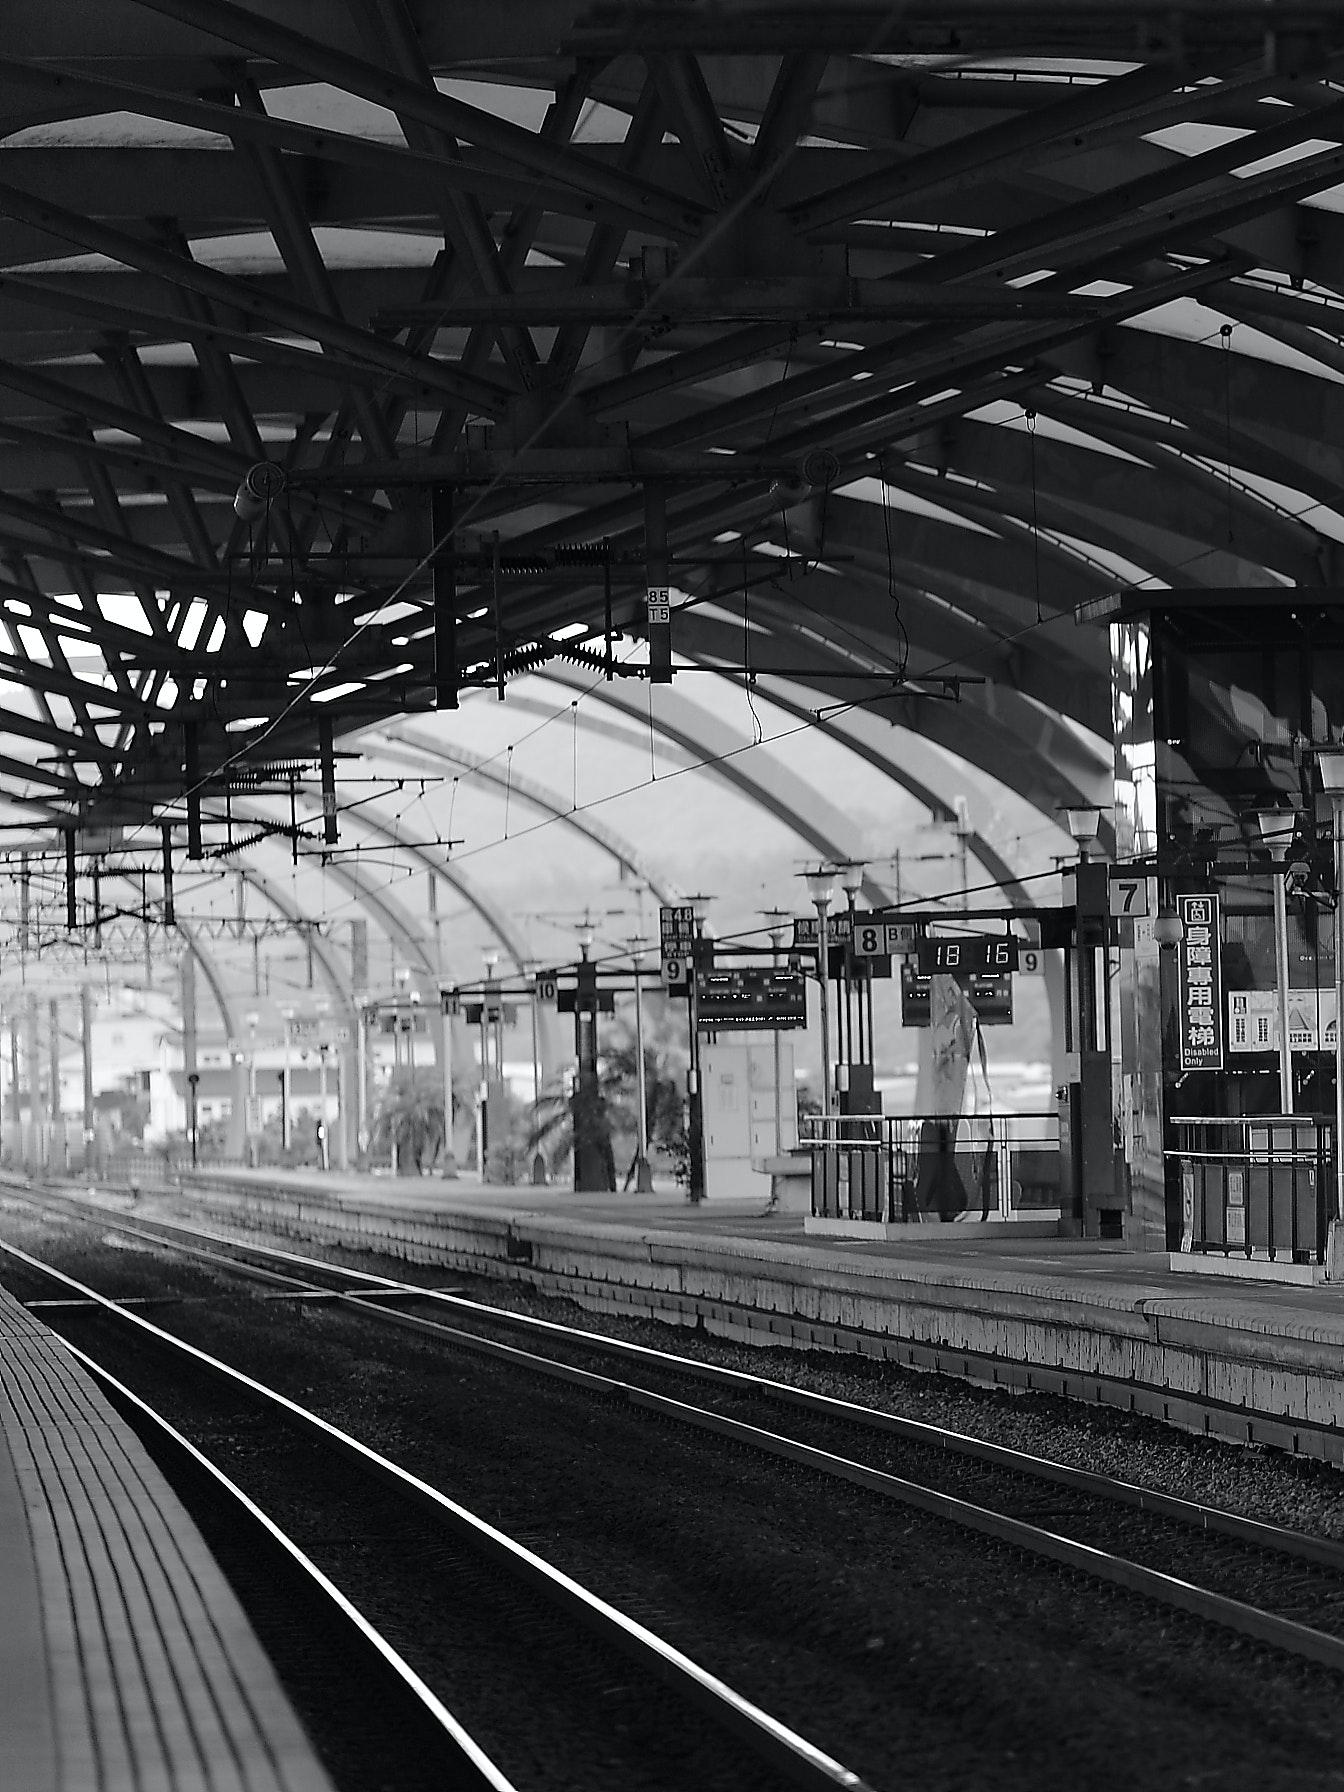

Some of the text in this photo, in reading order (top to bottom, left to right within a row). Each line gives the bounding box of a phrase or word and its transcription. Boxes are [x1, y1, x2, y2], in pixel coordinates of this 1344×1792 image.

[649, 591, 669, 603] 85
[649, 608, 669, 620] T5
[1119, 884, 1138, 912] 7
[862, 929, 878, 952] 8
[937, 944, 960, 966] 18
[1025, 953, 1037, 971] 9
[667, 961, 680, 979] 9
[540, 983, 555, 999] 10
[1185, 926, 1215, 1046] 身障專用電梯
[1184, 1048, 1219, 1057] Disabled
[1184, 1057, 1203, 1067] Only
